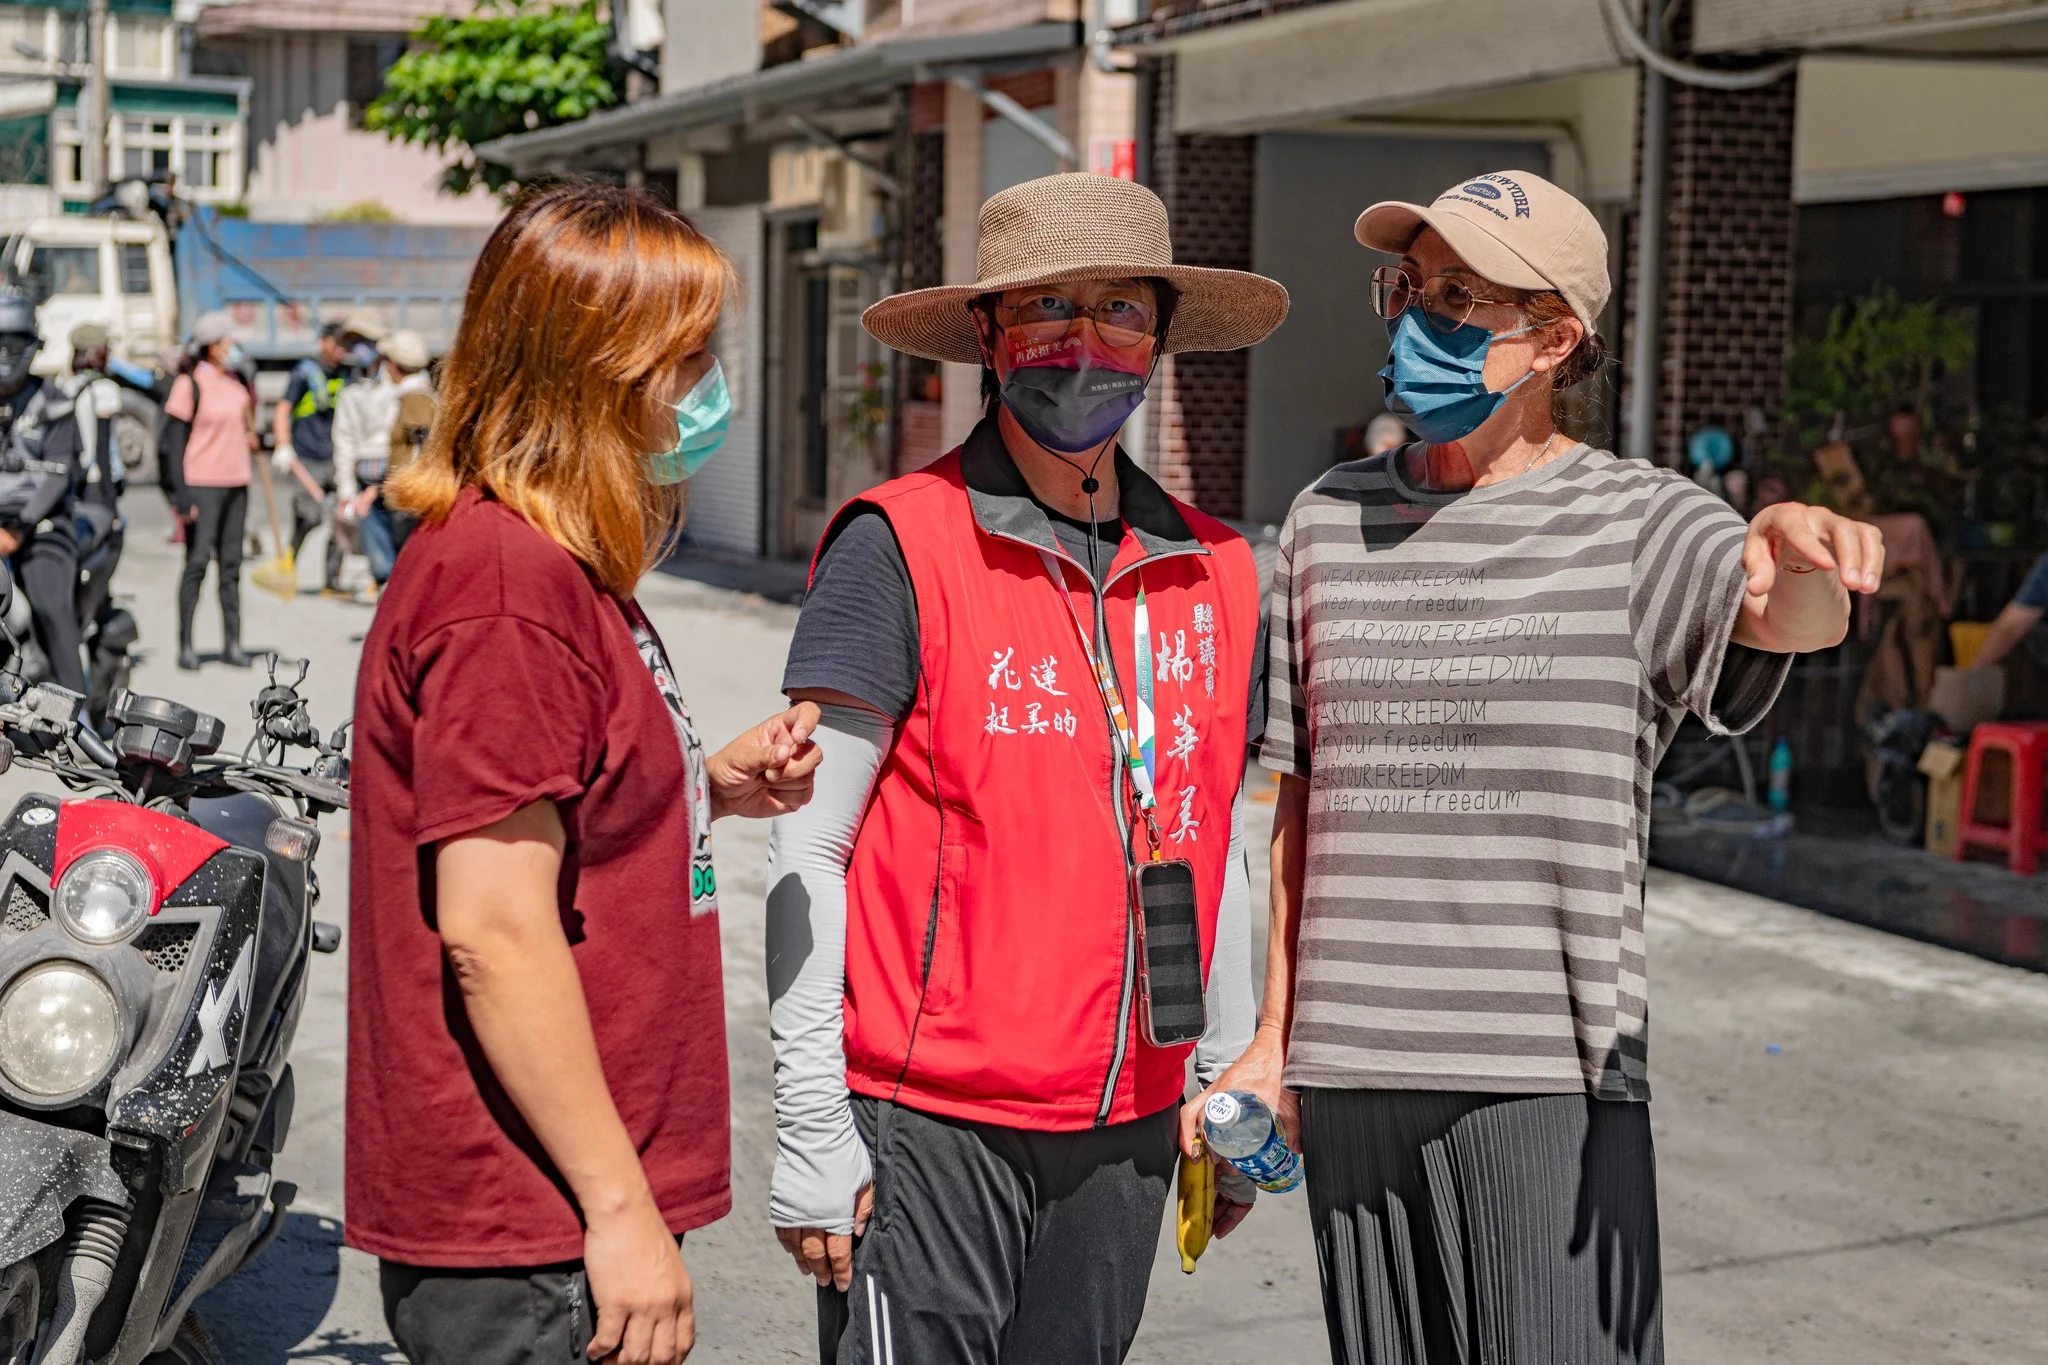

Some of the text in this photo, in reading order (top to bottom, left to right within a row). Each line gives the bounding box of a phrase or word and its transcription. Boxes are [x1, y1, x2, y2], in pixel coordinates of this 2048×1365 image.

[1320, 567, 1485, 588] WEARYOURFREEDOM
[1318, 615, 1560, 649] WEARYOURFREEDOM
[1192, 603, 1217, 700] 縣議員
[988, 646, 1068, 696] 花蓮
[1141, 670, 1149, 700] POWER
[1315, 653, 1554, 690] ARYOURFREEDOM
[984, 701, 1078, 738] 挺美的
[1314, 699, 1487, 726] ARYOURFREEDOM
[1313, 762, 1465, 789] EARYOURFREEDOM
[1211, 1103, 1227, 1115] FIN
